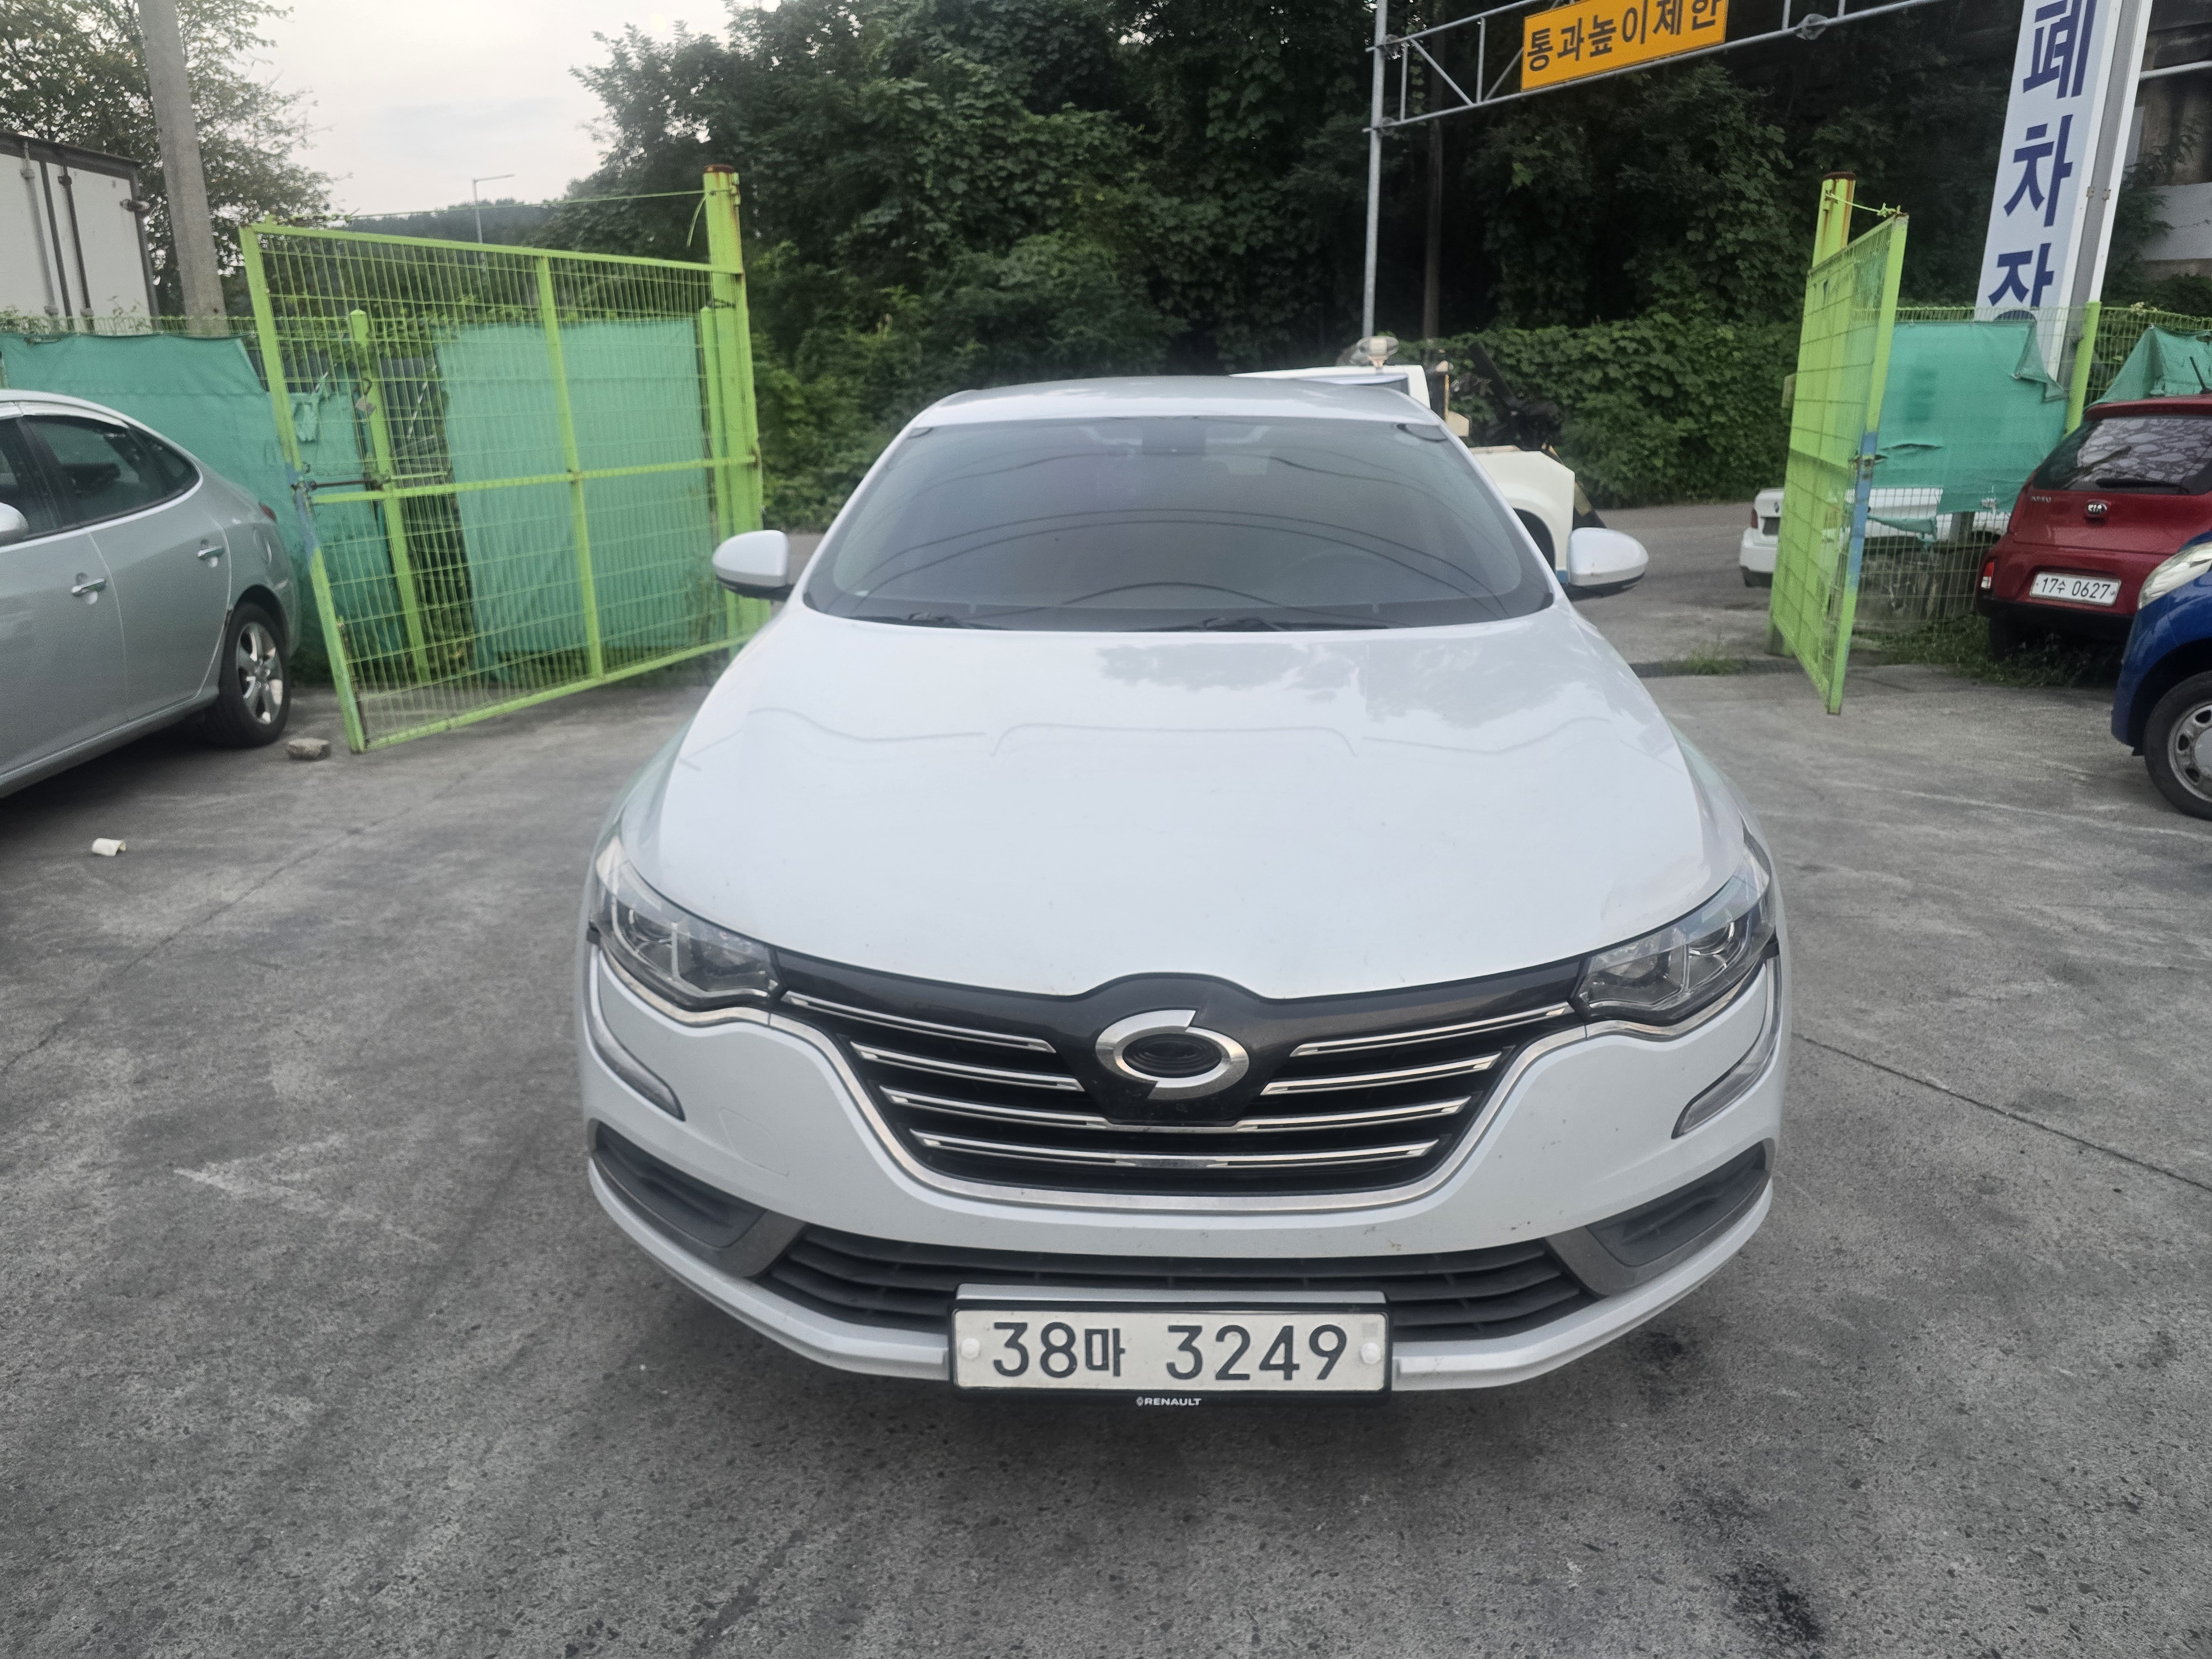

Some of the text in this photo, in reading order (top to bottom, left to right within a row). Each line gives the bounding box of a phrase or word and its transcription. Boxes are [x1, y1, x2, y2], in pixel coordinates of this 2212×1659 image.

[2042, 577, 2111, 599] 17수 0627
[993, 1321, 1348, 1381] 38마 3249
[1144, 1397, 1202, 1406] RENAULT
